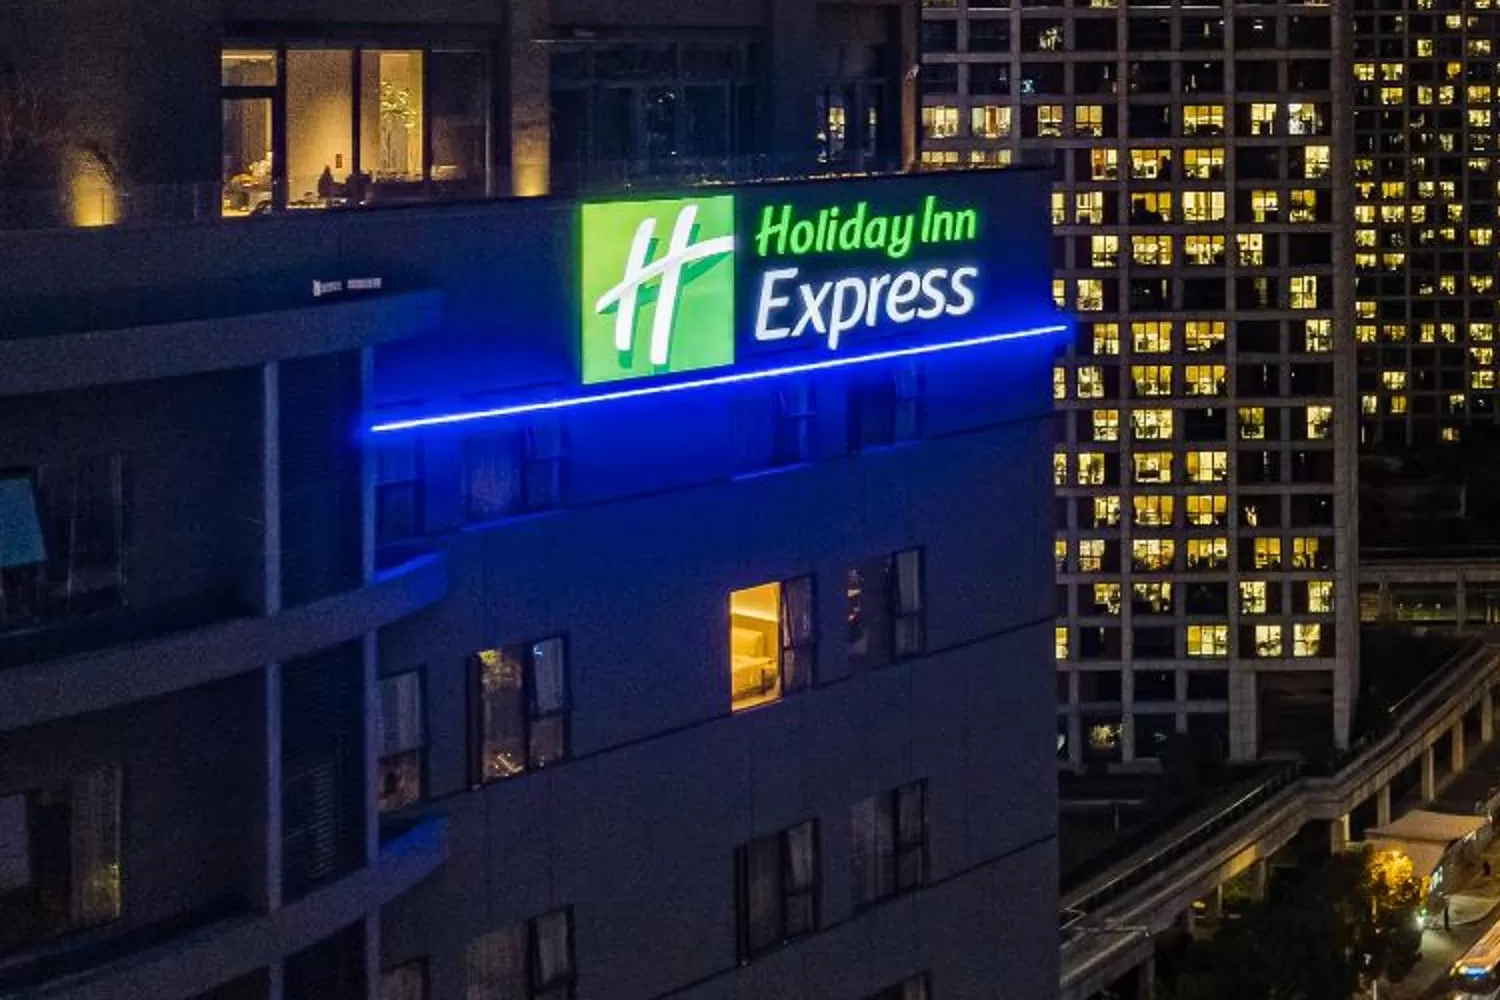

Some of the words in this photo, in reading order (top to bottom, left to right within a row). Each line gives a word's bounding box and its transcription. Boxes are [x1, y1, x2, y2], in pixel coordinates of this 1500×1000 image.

[756, 202, 914, 259] Holiday
[921, 195, 977, 243] Inn
[755, 267, 978, 351] Express
